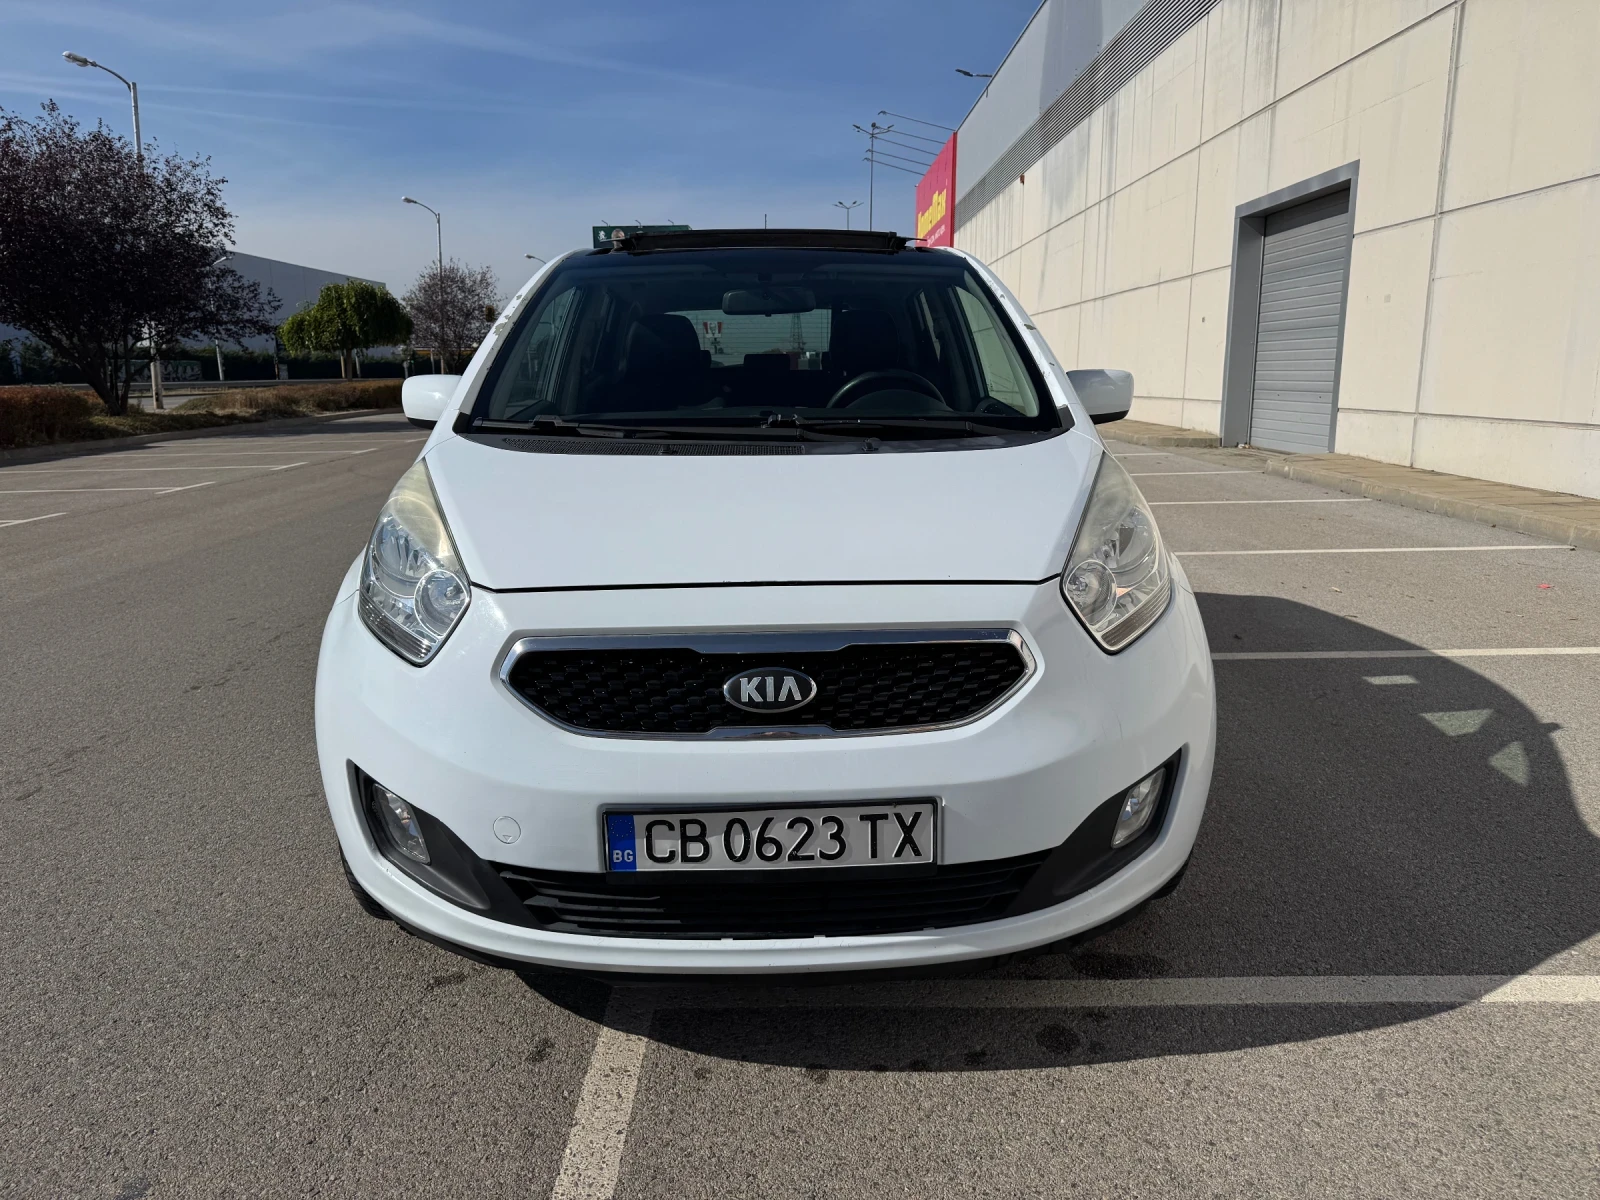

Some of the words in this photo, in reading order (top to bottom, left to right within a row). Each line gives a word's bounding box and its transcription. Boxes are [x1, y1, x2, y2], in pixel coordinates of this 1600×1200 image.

[739, 676, 802, 702] KIA
[644, 818, 710, 864] CB
[722, 816, 847, 862] 0623
[859, 811, 922, 858] TX
[612, 848, 634, 863] BG
